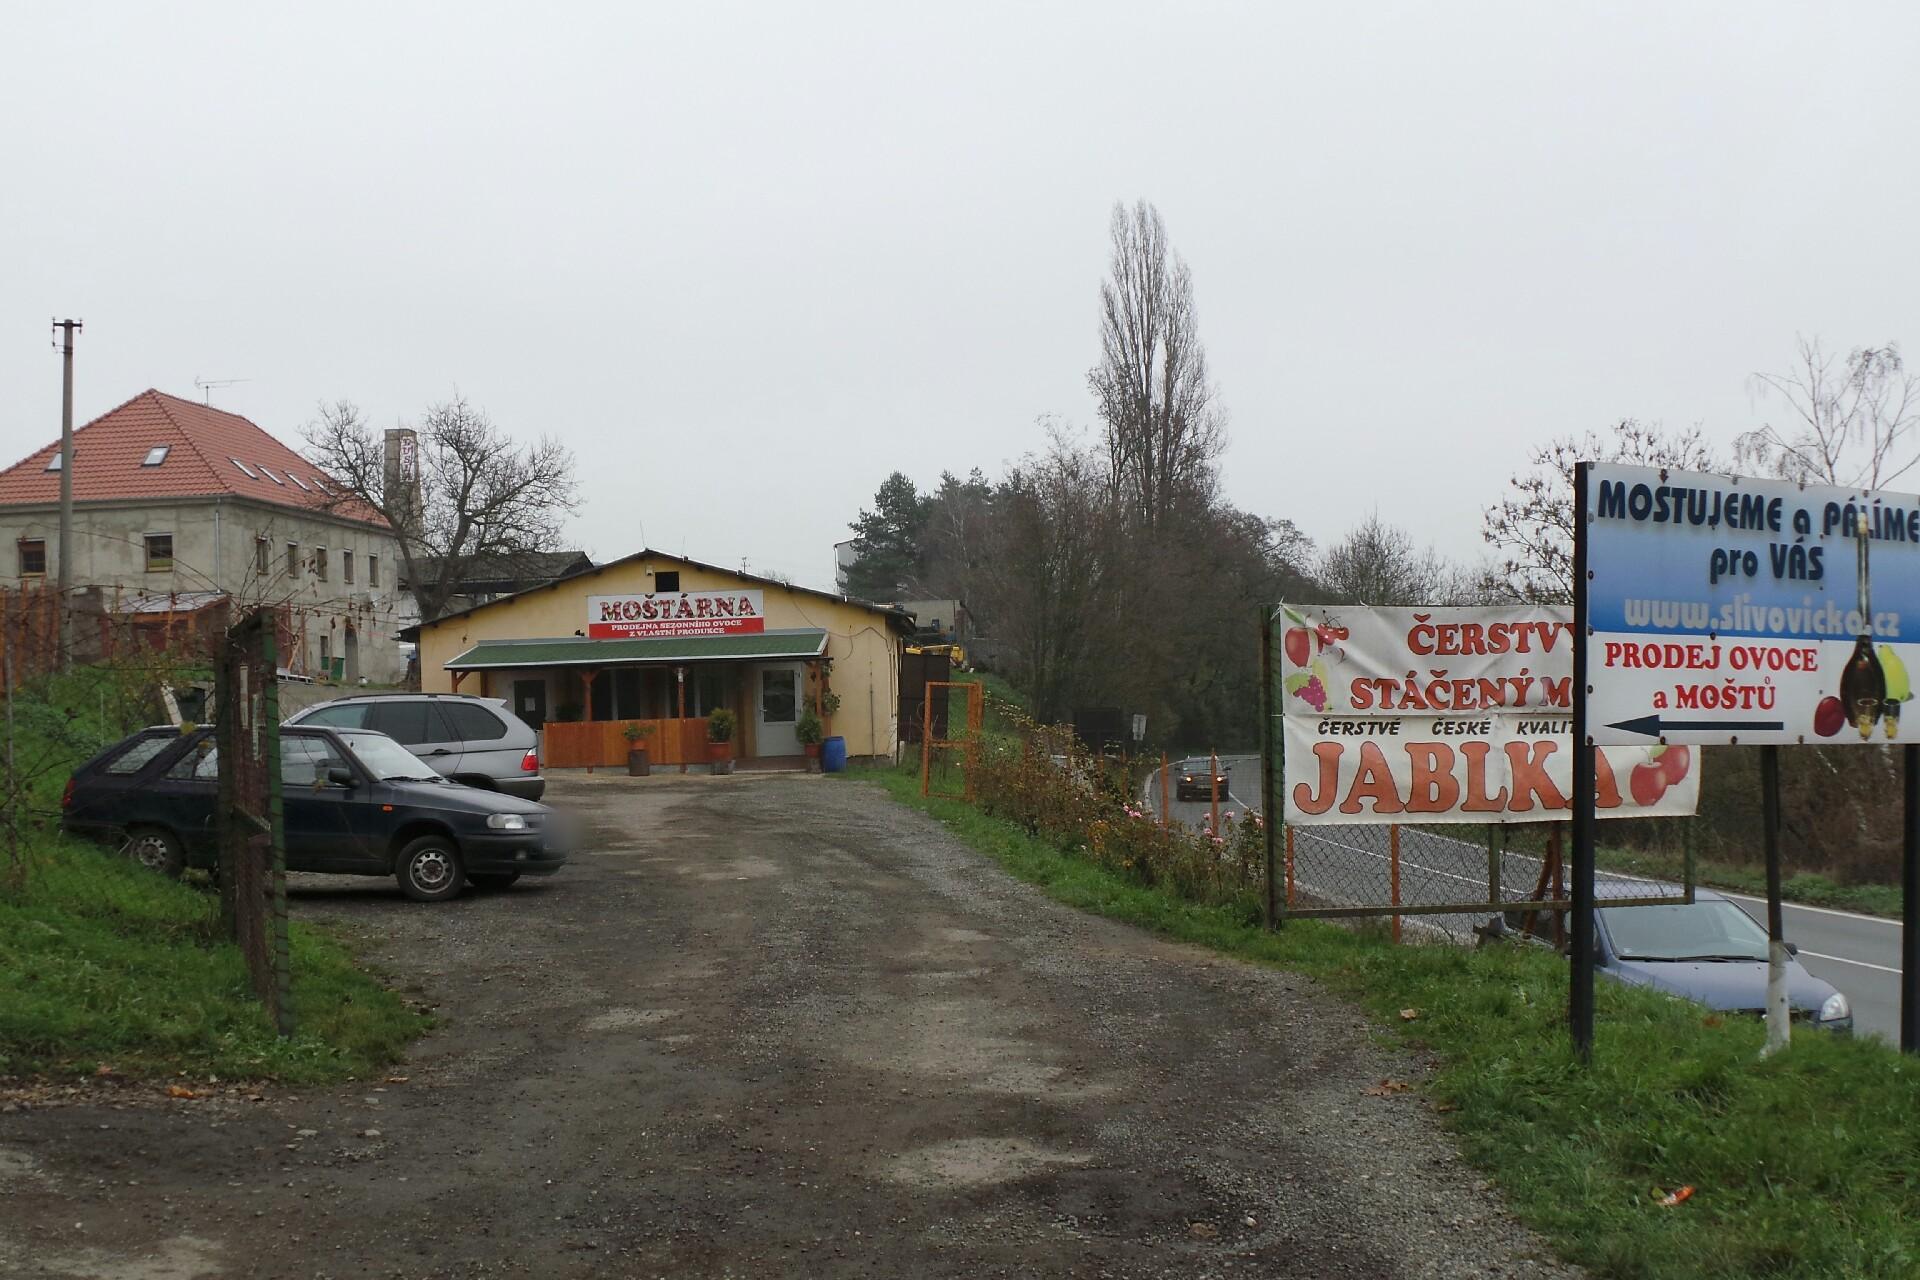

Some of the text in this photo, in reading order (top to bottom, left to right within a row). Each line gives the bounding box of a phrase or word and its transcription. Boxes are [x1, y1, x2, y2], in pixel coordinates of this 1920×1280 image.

[1793, 509, 1811, 535] a
[1710, 536, 1824, 584] pro VÁS
[600, 592, 756, 621] MOŠTÁRNA
[611, 619, 742, 631] PRODEJNA SEZONNÍHO OVOCE
[638, 628, 675, 636] VLASTNÍ
[677, 627, 725, 635] PRODUKCE
[1605, 643, 1818, 672] PRODEJ OVOCE
[1350, 668, 1534, 711] STÁČENÝ
[1653, 676, 1776, 710] a MOŠTŮ
[1317, 718, 1401, 736] ČERSTVÉ
[1432, 717, 1491, 736] ČESKÉ
